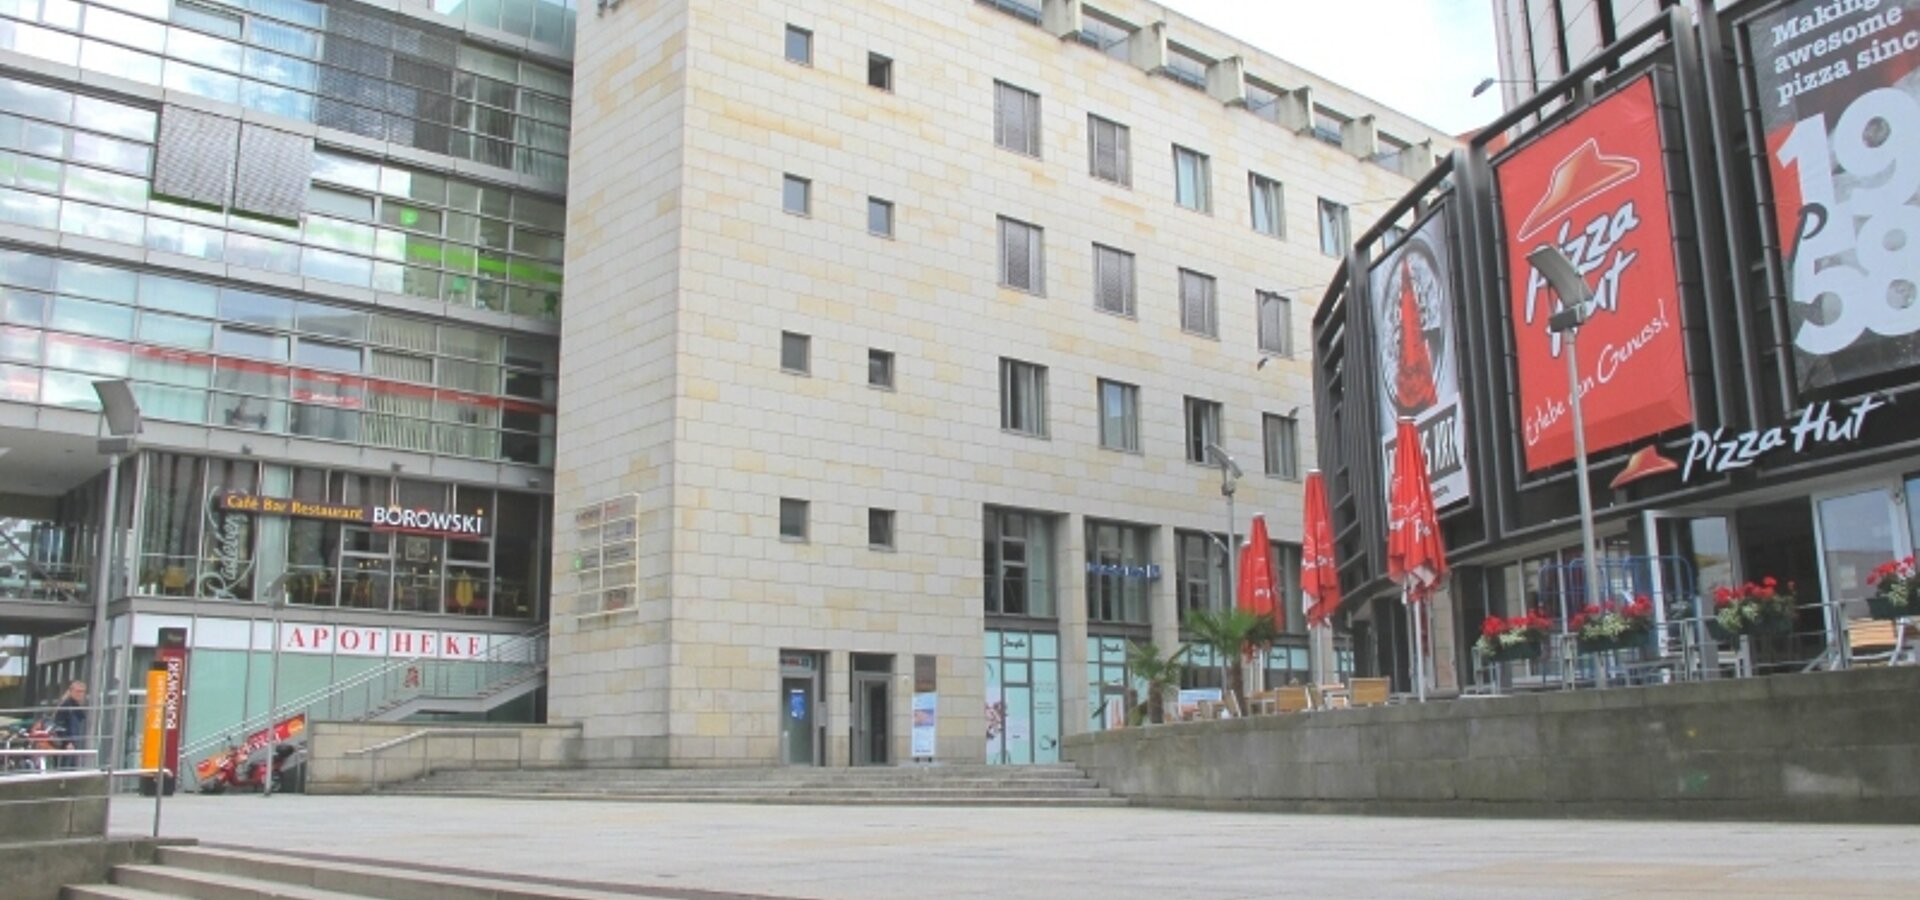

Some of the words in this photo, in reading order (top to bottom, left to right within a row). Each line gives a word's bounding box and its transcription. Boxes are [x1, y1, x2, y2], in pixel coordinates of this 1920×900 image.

[1774, 6, 1903, 74] awesome
[1777, 59, 1851, 107] pizza
[1857, 29, 1920, 70] sinc
[1525, 397, 1566, 446] Erlebe
[1596, 298, 1670, 384] Genuss!
[1681, 426, 1786, 483] Pizza
[1789, 396, 1885, 453] Hut
[227, 494, 259, 510] Café
[263, 499, 287, 512] Bar
[291, 501, 364, 520] Restaurant
[287, 626, 482, 656] APOTHEKE
